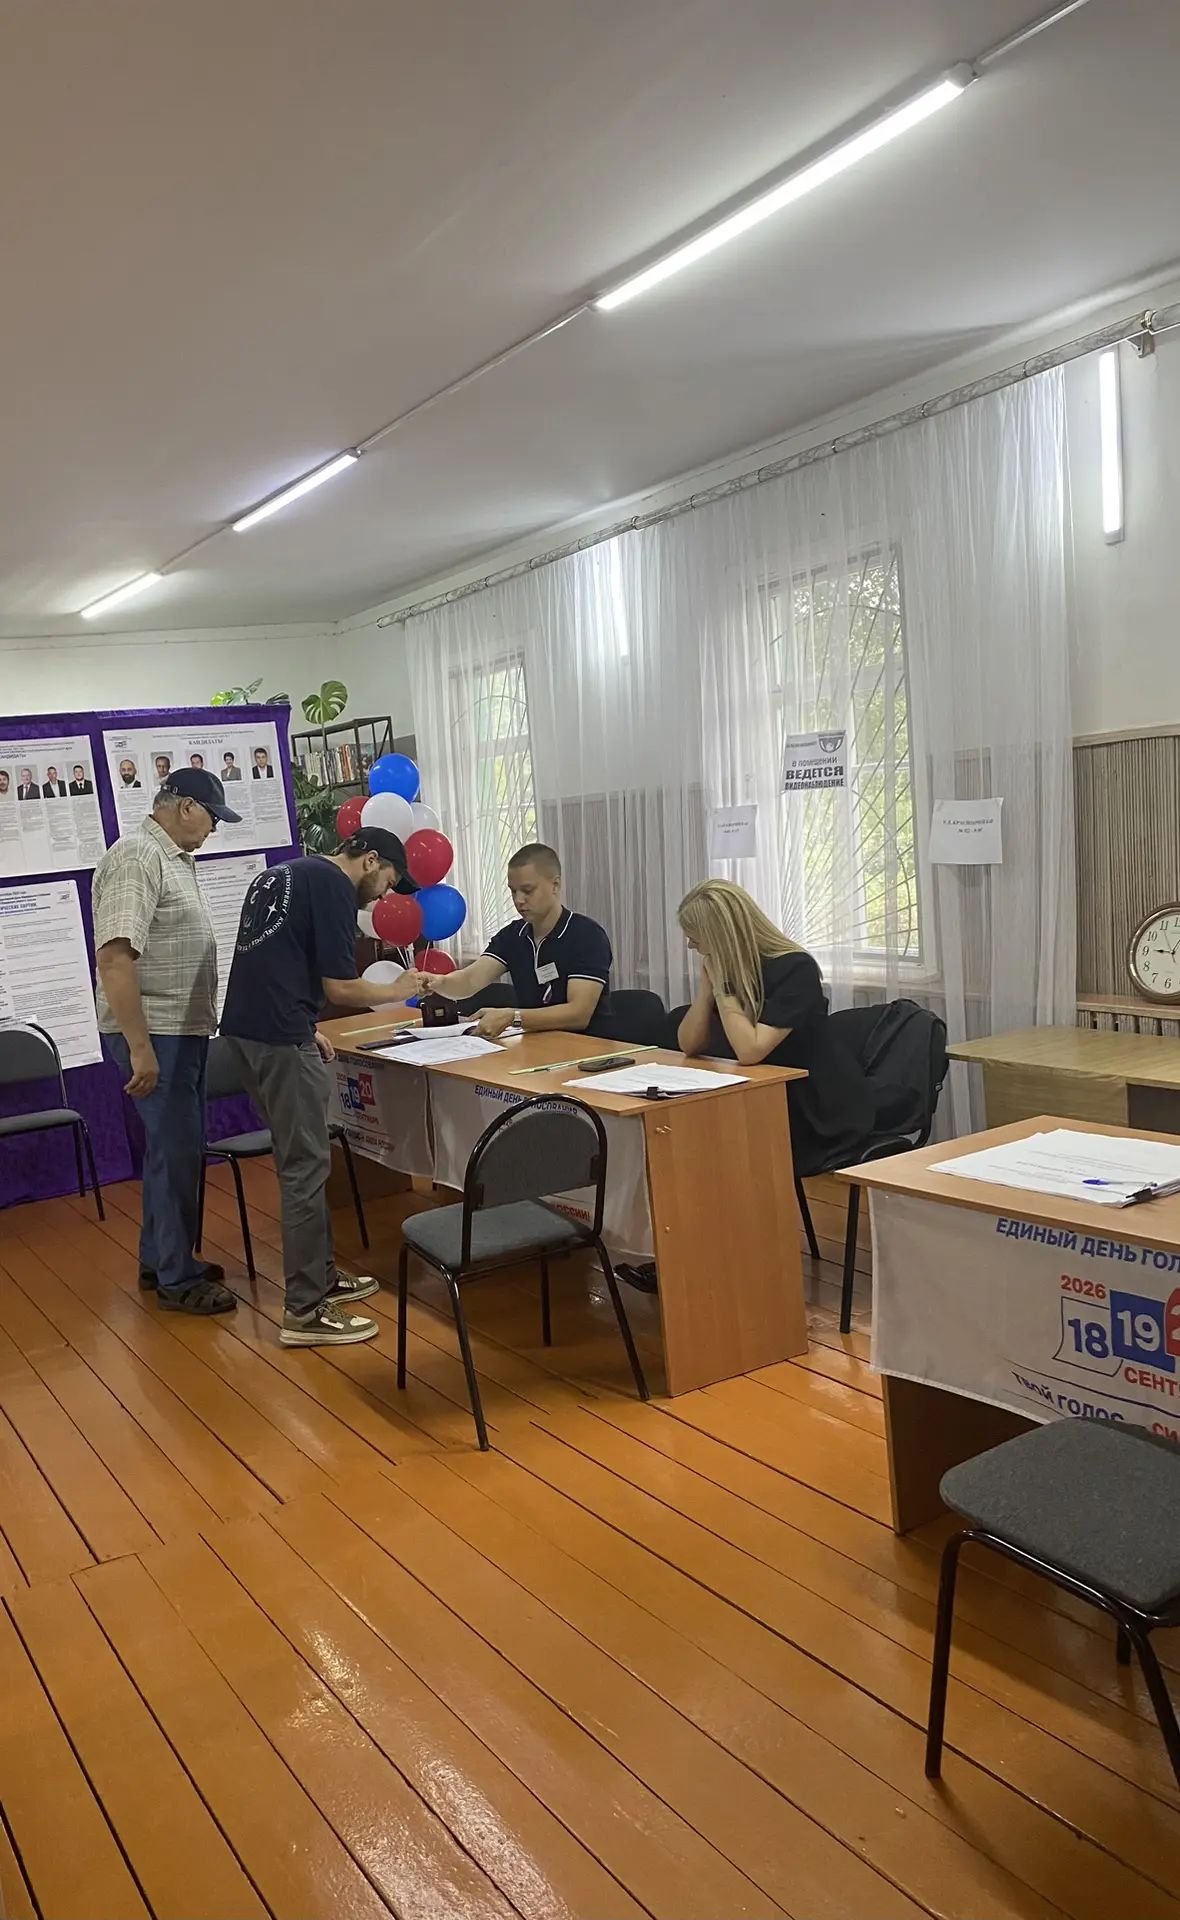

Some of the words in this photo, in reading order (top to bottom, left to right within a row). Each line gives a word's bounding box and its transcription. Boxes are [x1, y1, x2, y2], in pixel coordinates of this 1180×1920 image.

[785, 765, 844, 781] ВЕДЕТСЯ
[784, 778, 844, 791] ВИДЕОНАБЛЮДЕНИЕ
[1160, 920, 1169, 931] 11
[1147, 930, 1158, 942] 10
[1142, 945, 1150, 957] 9
[1143, 960, 1151, 972] 8
[1151, 972, 1159, 984] 7
[1164, 977, 1172, 990] 6
[340, 1092, 351, 1109] 18
[360, 1080, 372, 1099] 20
[474, 1084, 503, 1101] ЕДИНЫЙ
[996, 1217, 1077, 1250] ЕДИНЫЙ
[1080, 1236, 1137, 1264] ДЕНЬ
[1060, 1274, 1107, 1300] 2026
[1067, 1317, 1110, 1359] 18
[1117, 1309, 1161, 1352] 19
[1010, 1370, 1054, 1404] ТВОЙ
[1123, 1366, 1180, 1398] СЕНТ
